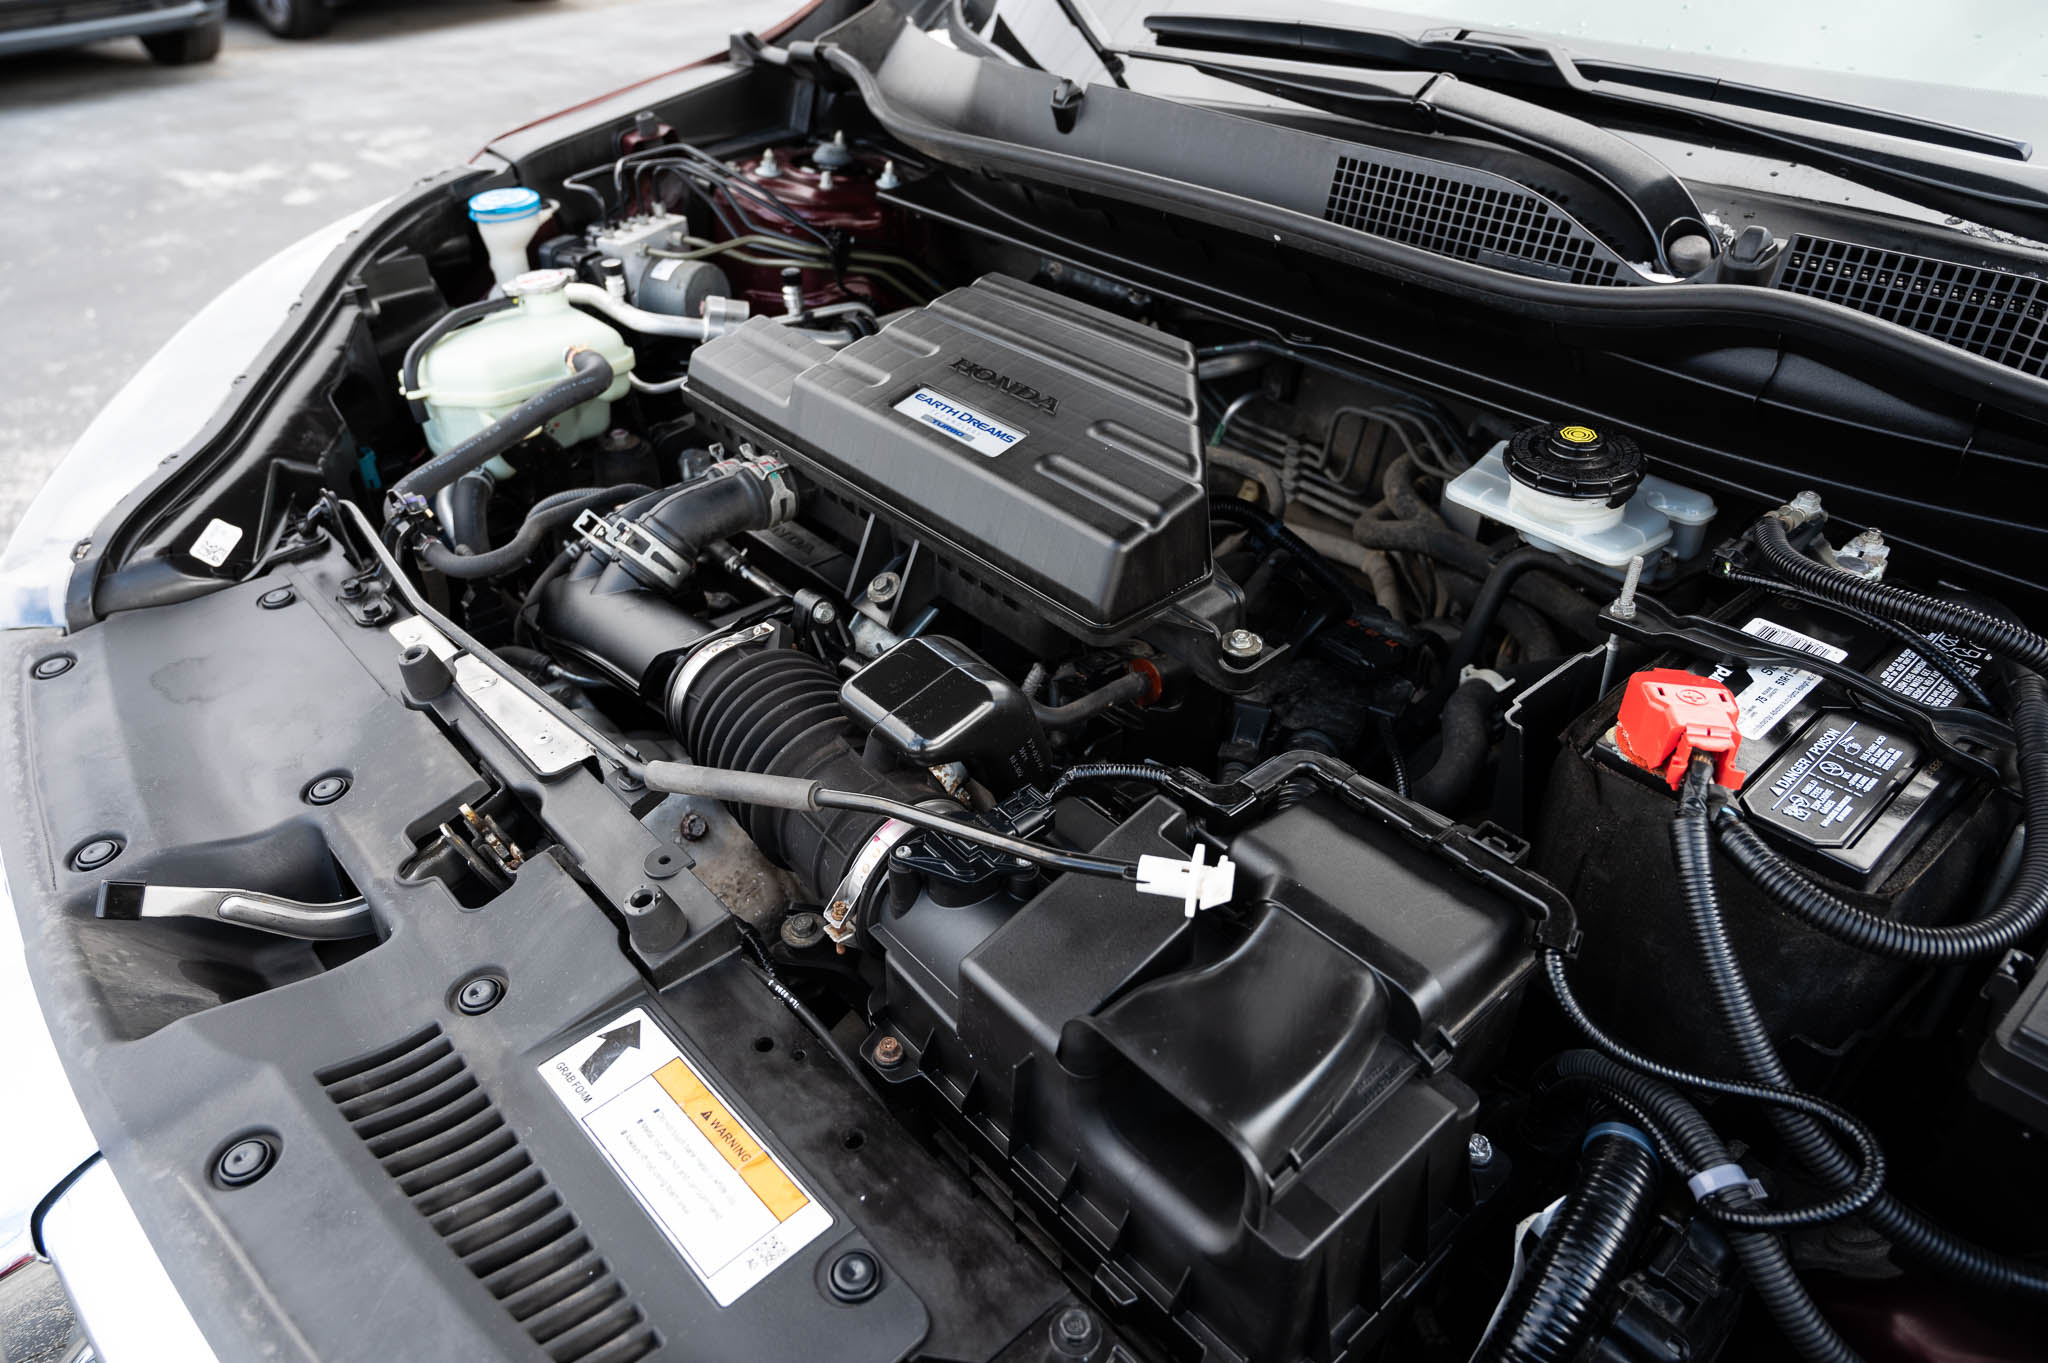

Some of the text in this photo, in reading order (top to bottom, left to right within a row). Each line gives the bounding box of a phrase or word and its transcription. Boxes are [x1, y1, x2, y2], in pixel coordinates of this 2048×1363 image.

[949, 357, 1061, 416] HONDA
[915, 393, 960, 417] EARTH
[957, 412, 1017, 444] DREAMS
[931, 418, 966, 438] TURBO
[1775, 757, 1811, 789] DANGER
[1809, 727, 1841, 756] POISON
[556, 1062, 593, 1103] GRAB FOAM
[710, 1118, 751, 1162] WARNING
